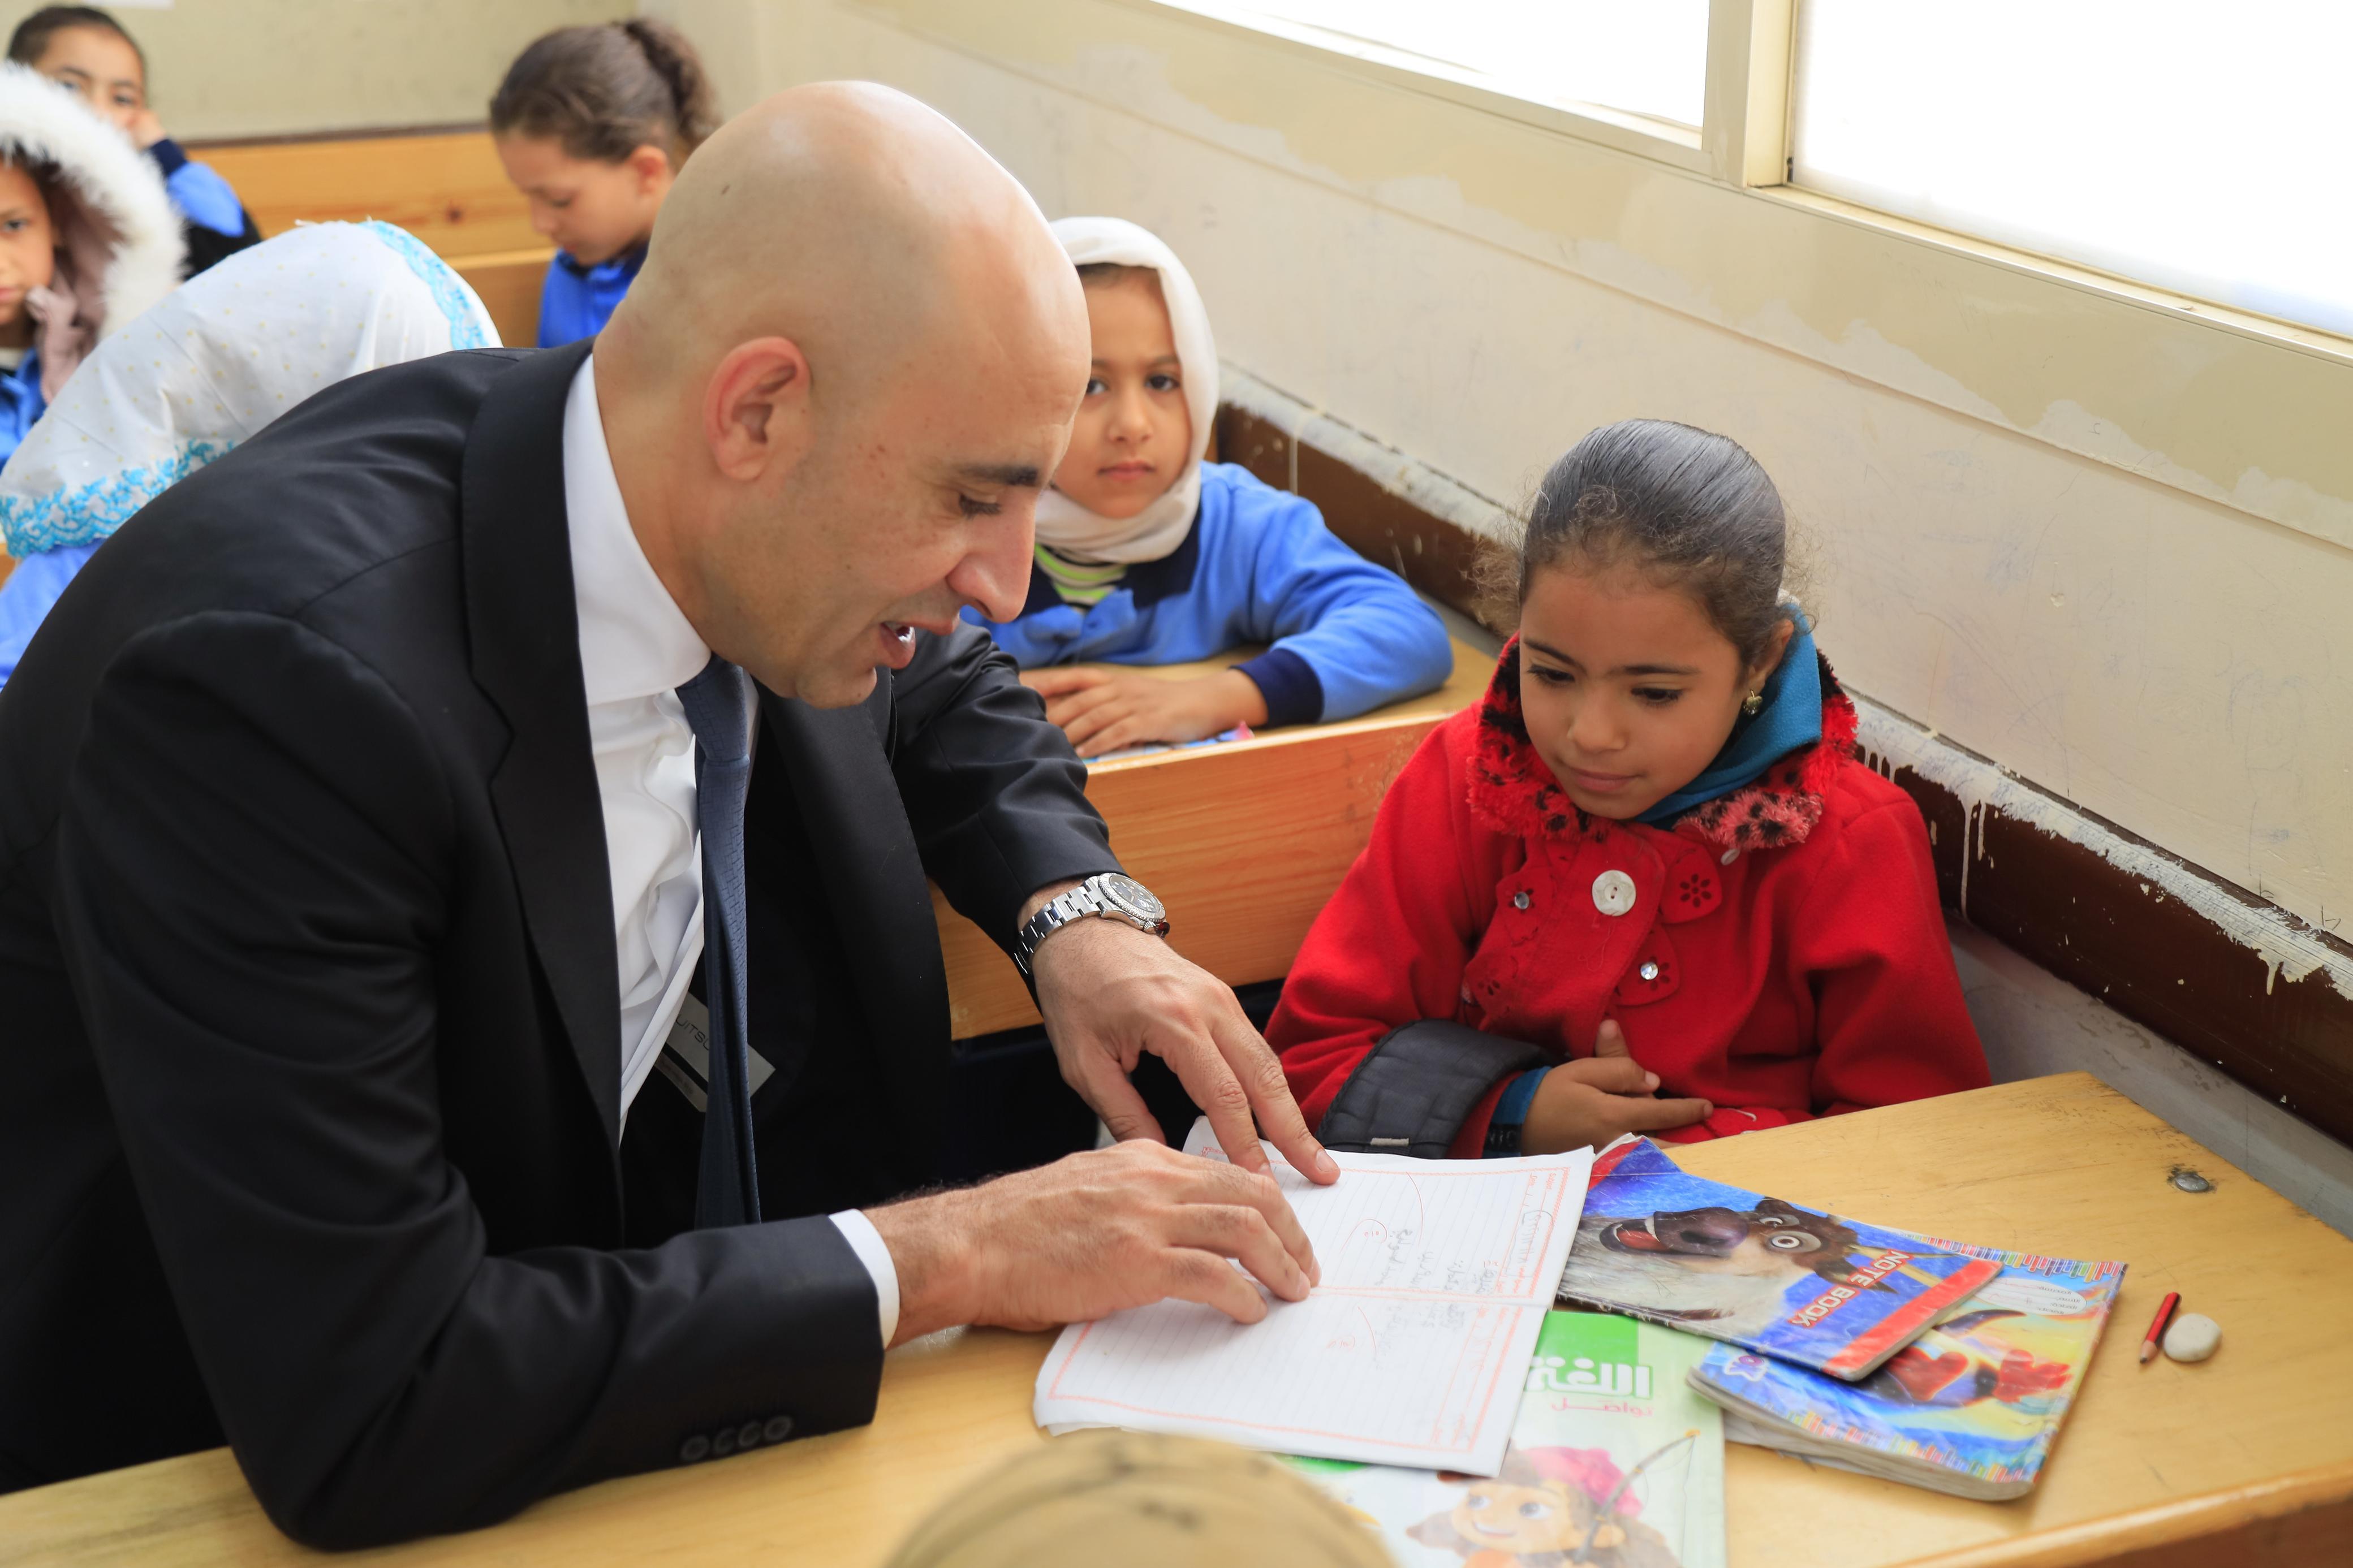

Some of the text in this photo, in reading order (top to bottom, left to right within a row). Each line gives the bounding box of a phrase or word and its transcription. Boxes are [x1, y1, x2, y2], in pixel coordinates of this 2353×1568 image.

[675, 1014, 709, 1051] UITSU
[1791, 1249, 1911, 1327] NOTE BOOK
[1524, 1356, 1652, 1399] اللغة
